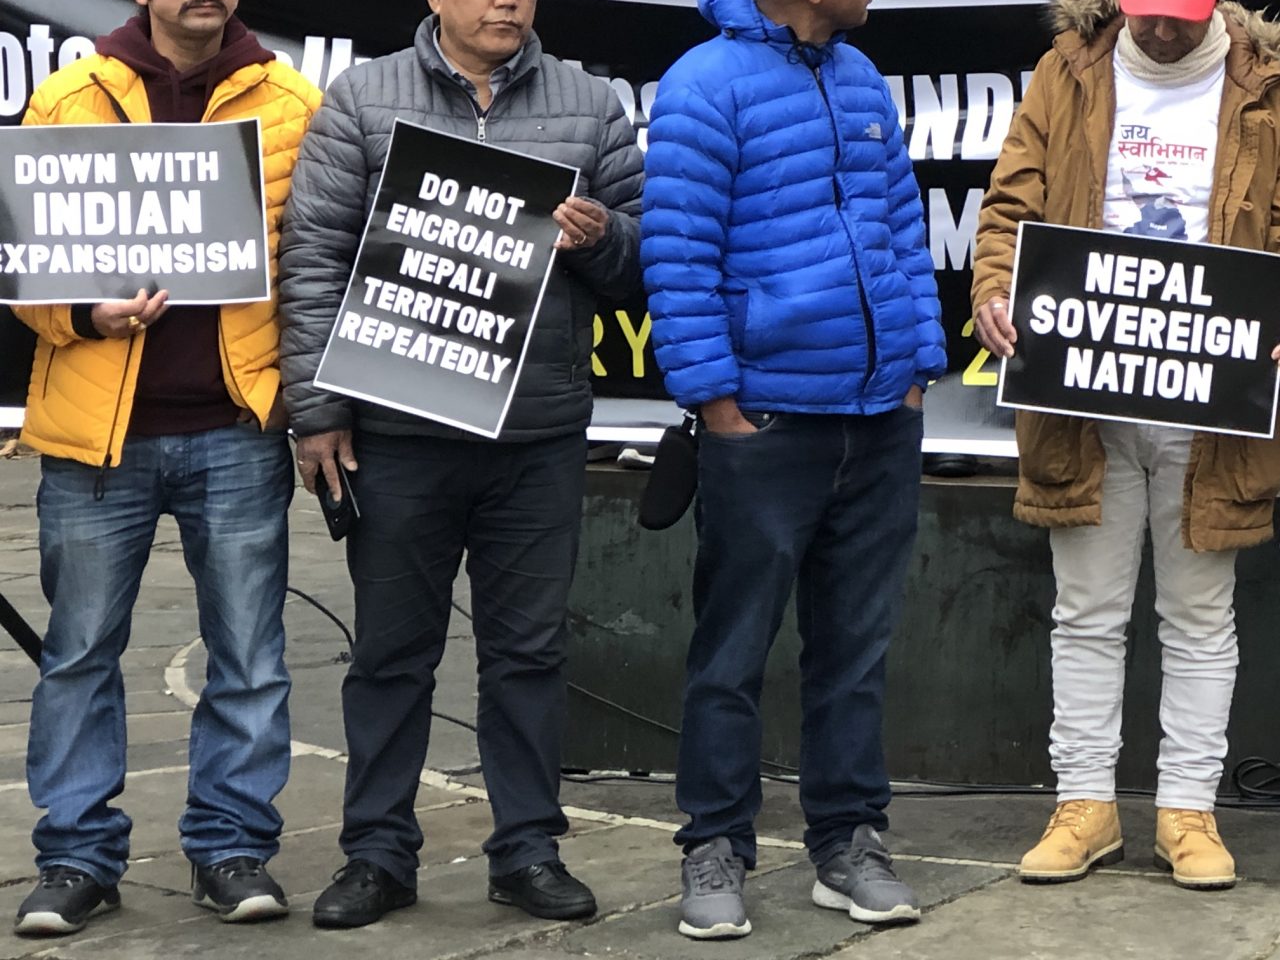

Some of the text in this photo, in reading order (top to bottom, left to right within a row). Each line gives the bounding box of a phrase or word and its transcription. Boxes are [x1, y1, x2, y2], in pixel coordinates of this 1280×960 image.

[1118, 136, 1208, 162] स्वाभिमान
[1120, 124, 1151, 140] जय
[14, 151, 219, 185] DOWN WITH
[33, 189, 203, 236] INDIAN
[418, 171, 525, 226] DO NOT
[0, 239, 257, 275] XPANSIONSISM
[385, 202, 535, 270] ENCROACH
[399, 247, 498, 300] NEPALI
[1084, 252, 1213, 307] NEPAL
[363, 276, 516, 345] TERRITORY
[1029, 294, 1261, 361] SOVEREIGN
[338, 310, 513, 384] REPEATEDLY
[1063, 346, 1214, 404] NATION
